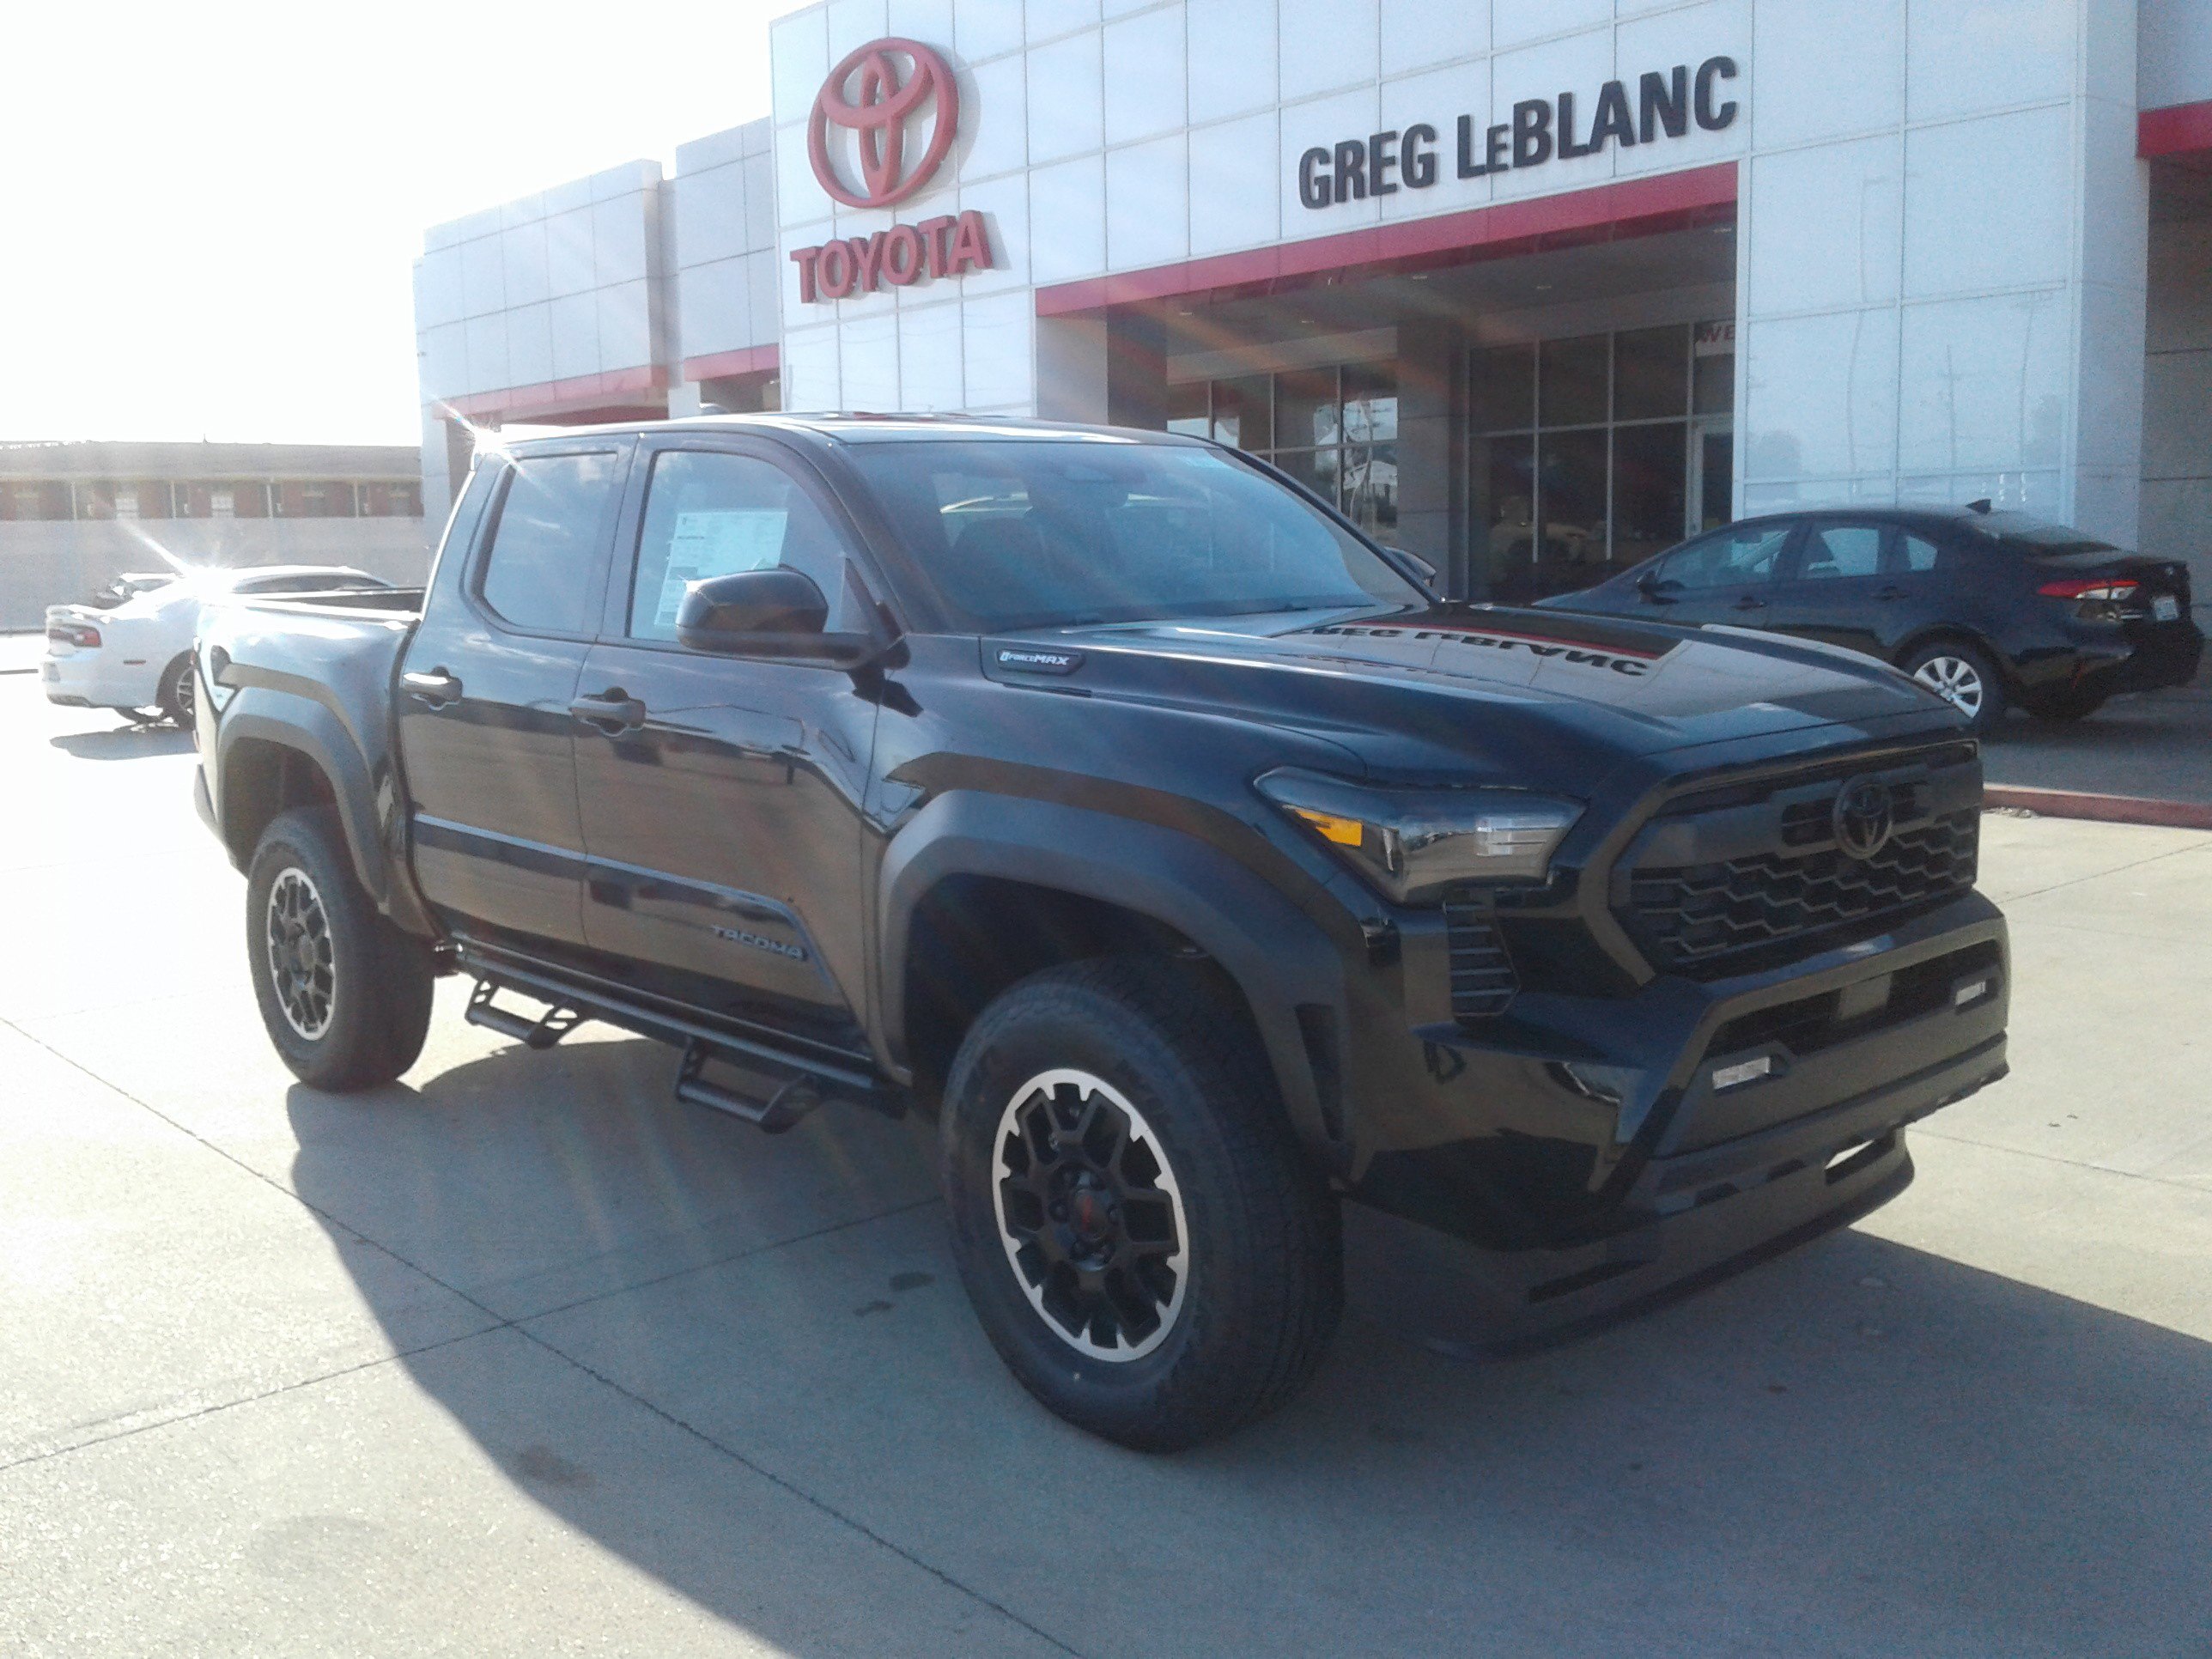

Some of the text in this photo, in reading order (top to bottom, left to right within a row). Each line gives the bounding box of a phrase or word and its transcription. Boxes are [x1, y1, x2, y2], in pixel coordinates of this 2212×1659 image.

[1299, 123, 1437, 210] GREG
[790, 210, 994, 304] TOYOTA
[711, 924, 807, 961] TACOMA
